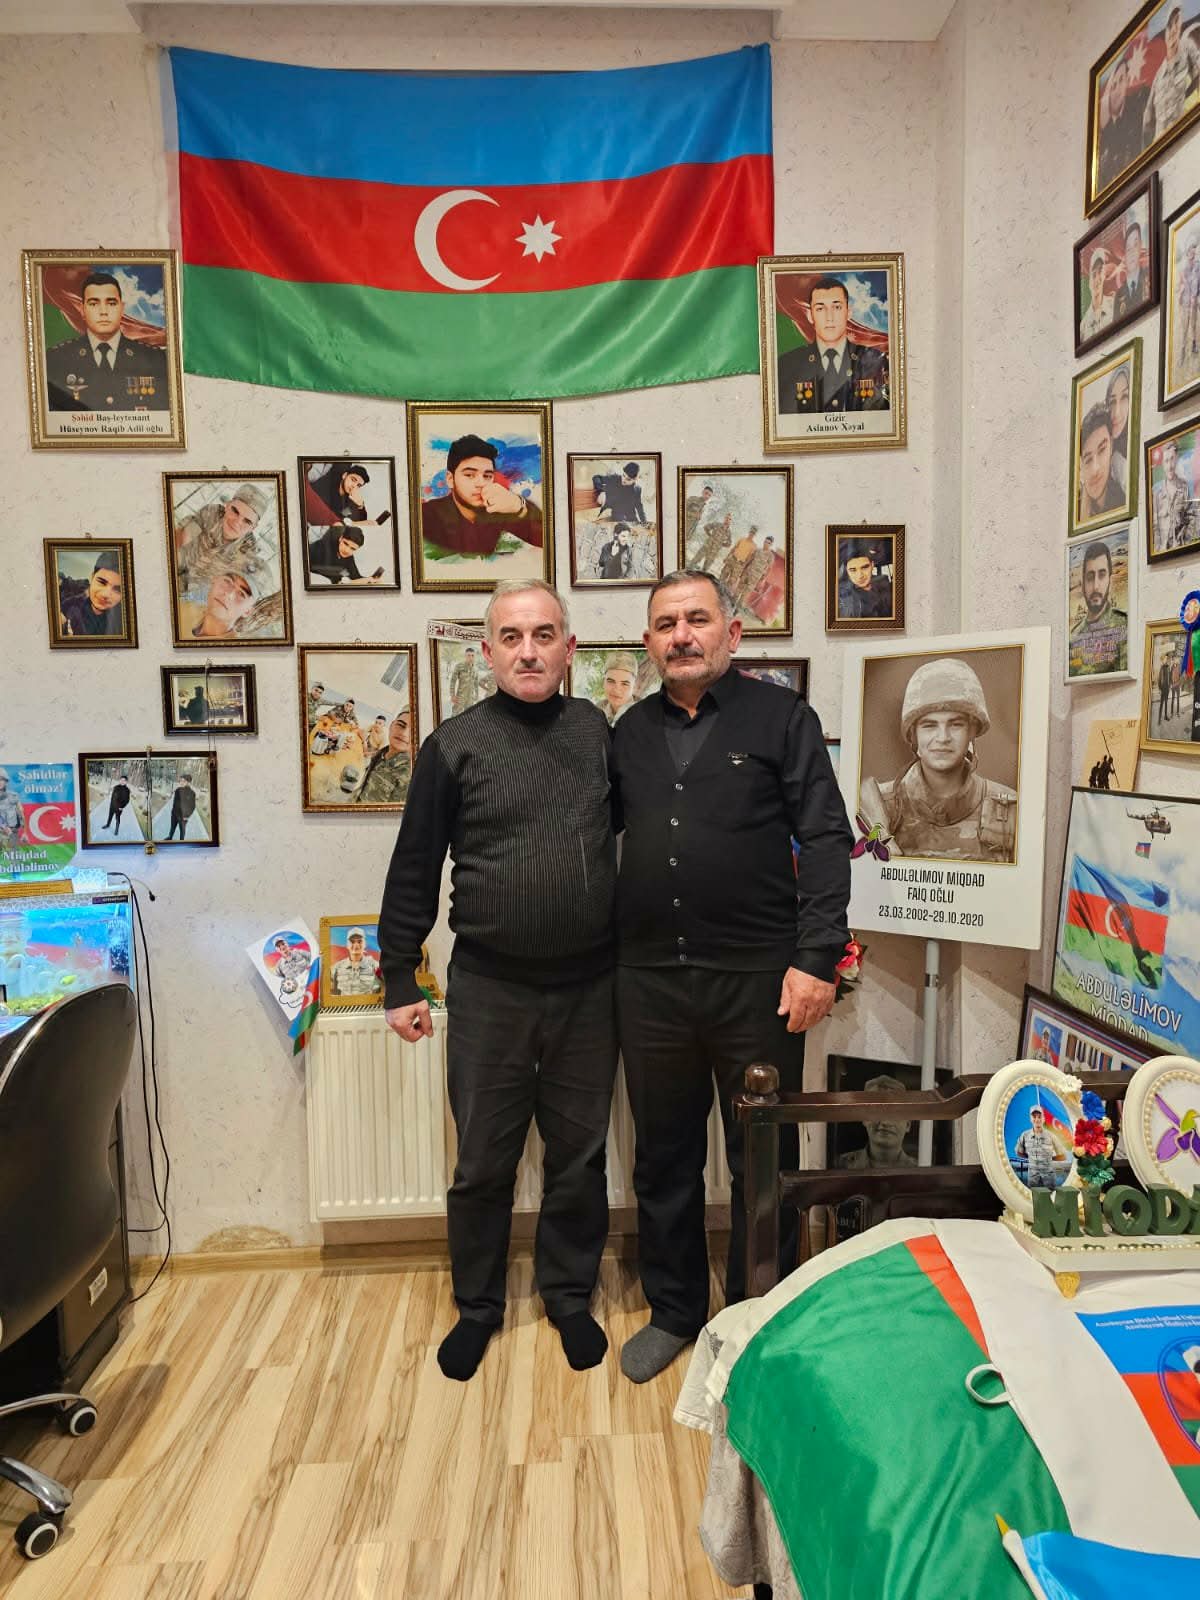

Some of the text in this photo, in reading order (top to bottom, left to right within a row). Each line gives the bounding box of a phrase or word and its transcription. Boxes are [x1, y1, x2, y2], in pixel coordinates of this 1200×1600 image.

[0, 862, 60, 873] bduləlimov
[880, 867, 985, 888] ABDULƏLİMOV MİQDAD
[907, 886, 955, 904] FAİQ OĞLU
[1076, 972, 1183, 1033] ABDULƏLİMOV
[1030, 1184, 1200, 1238] MİQD
